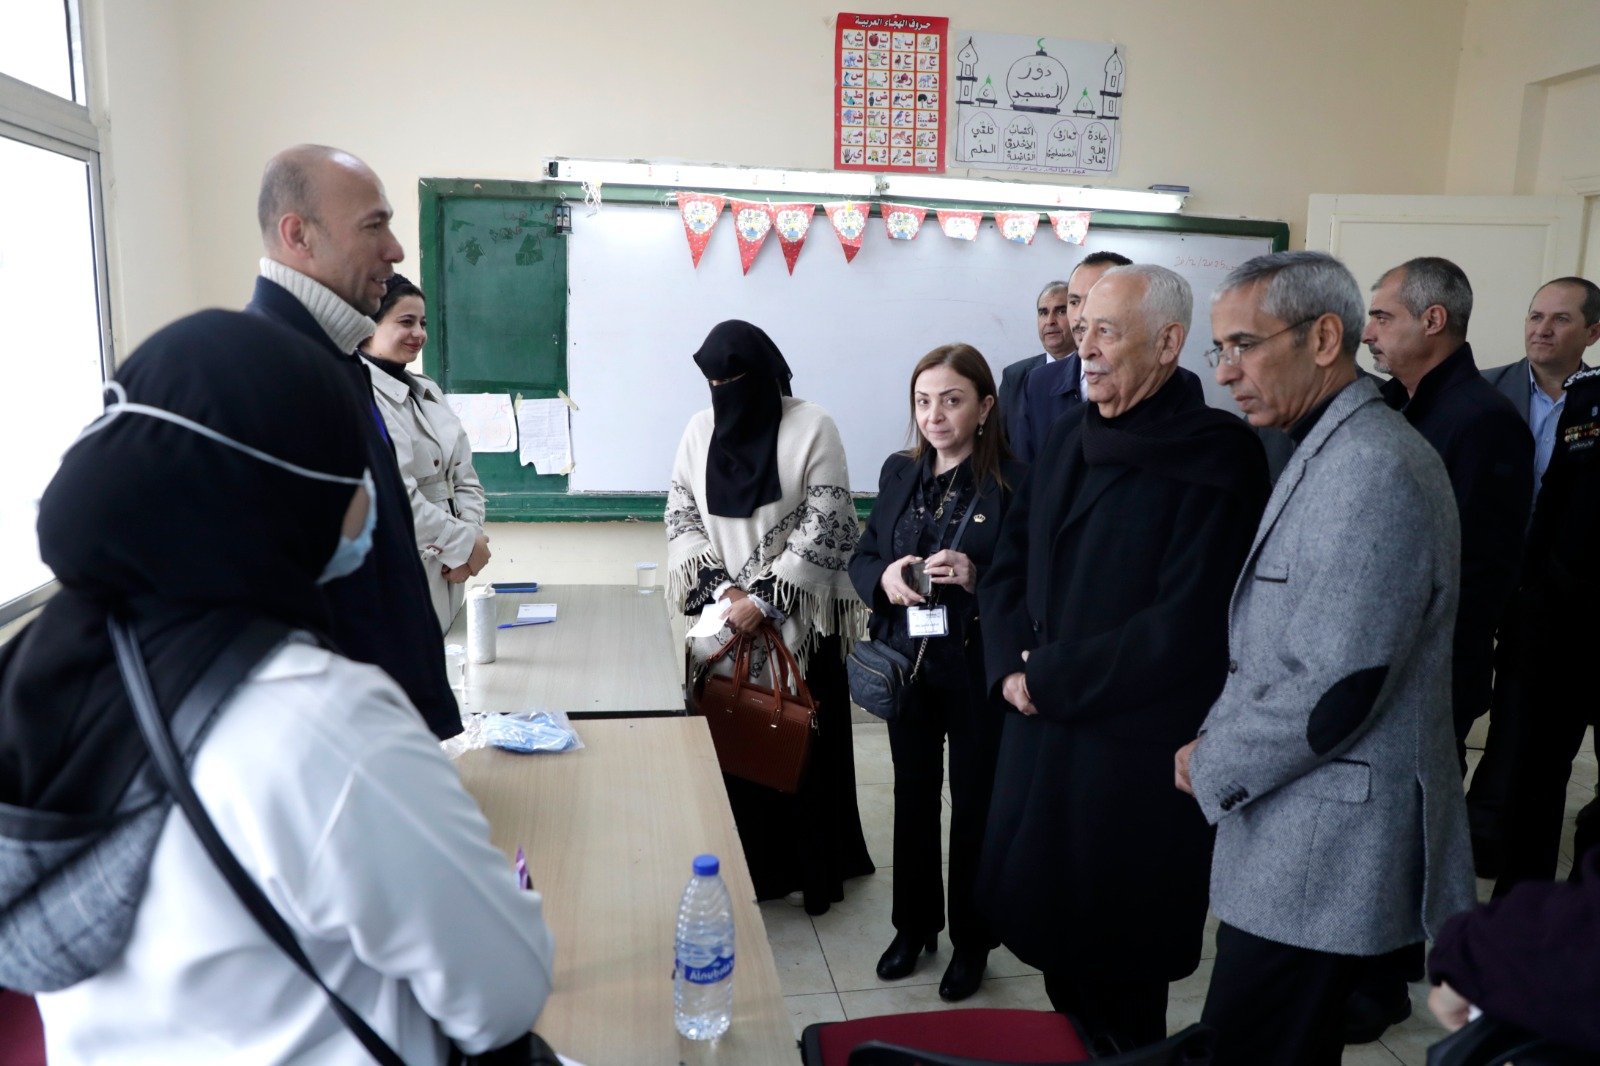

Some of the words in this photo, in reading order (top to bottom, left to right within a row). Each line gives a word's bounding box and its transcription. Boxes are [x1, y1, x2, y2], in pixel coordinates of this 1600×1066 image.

[855, 16, 882, 29] العربية
[885, 19, 908, 29] الهجاء
[908, 18, 930, 30] حروف
[1012, 83, 1063, 101] المسجد
